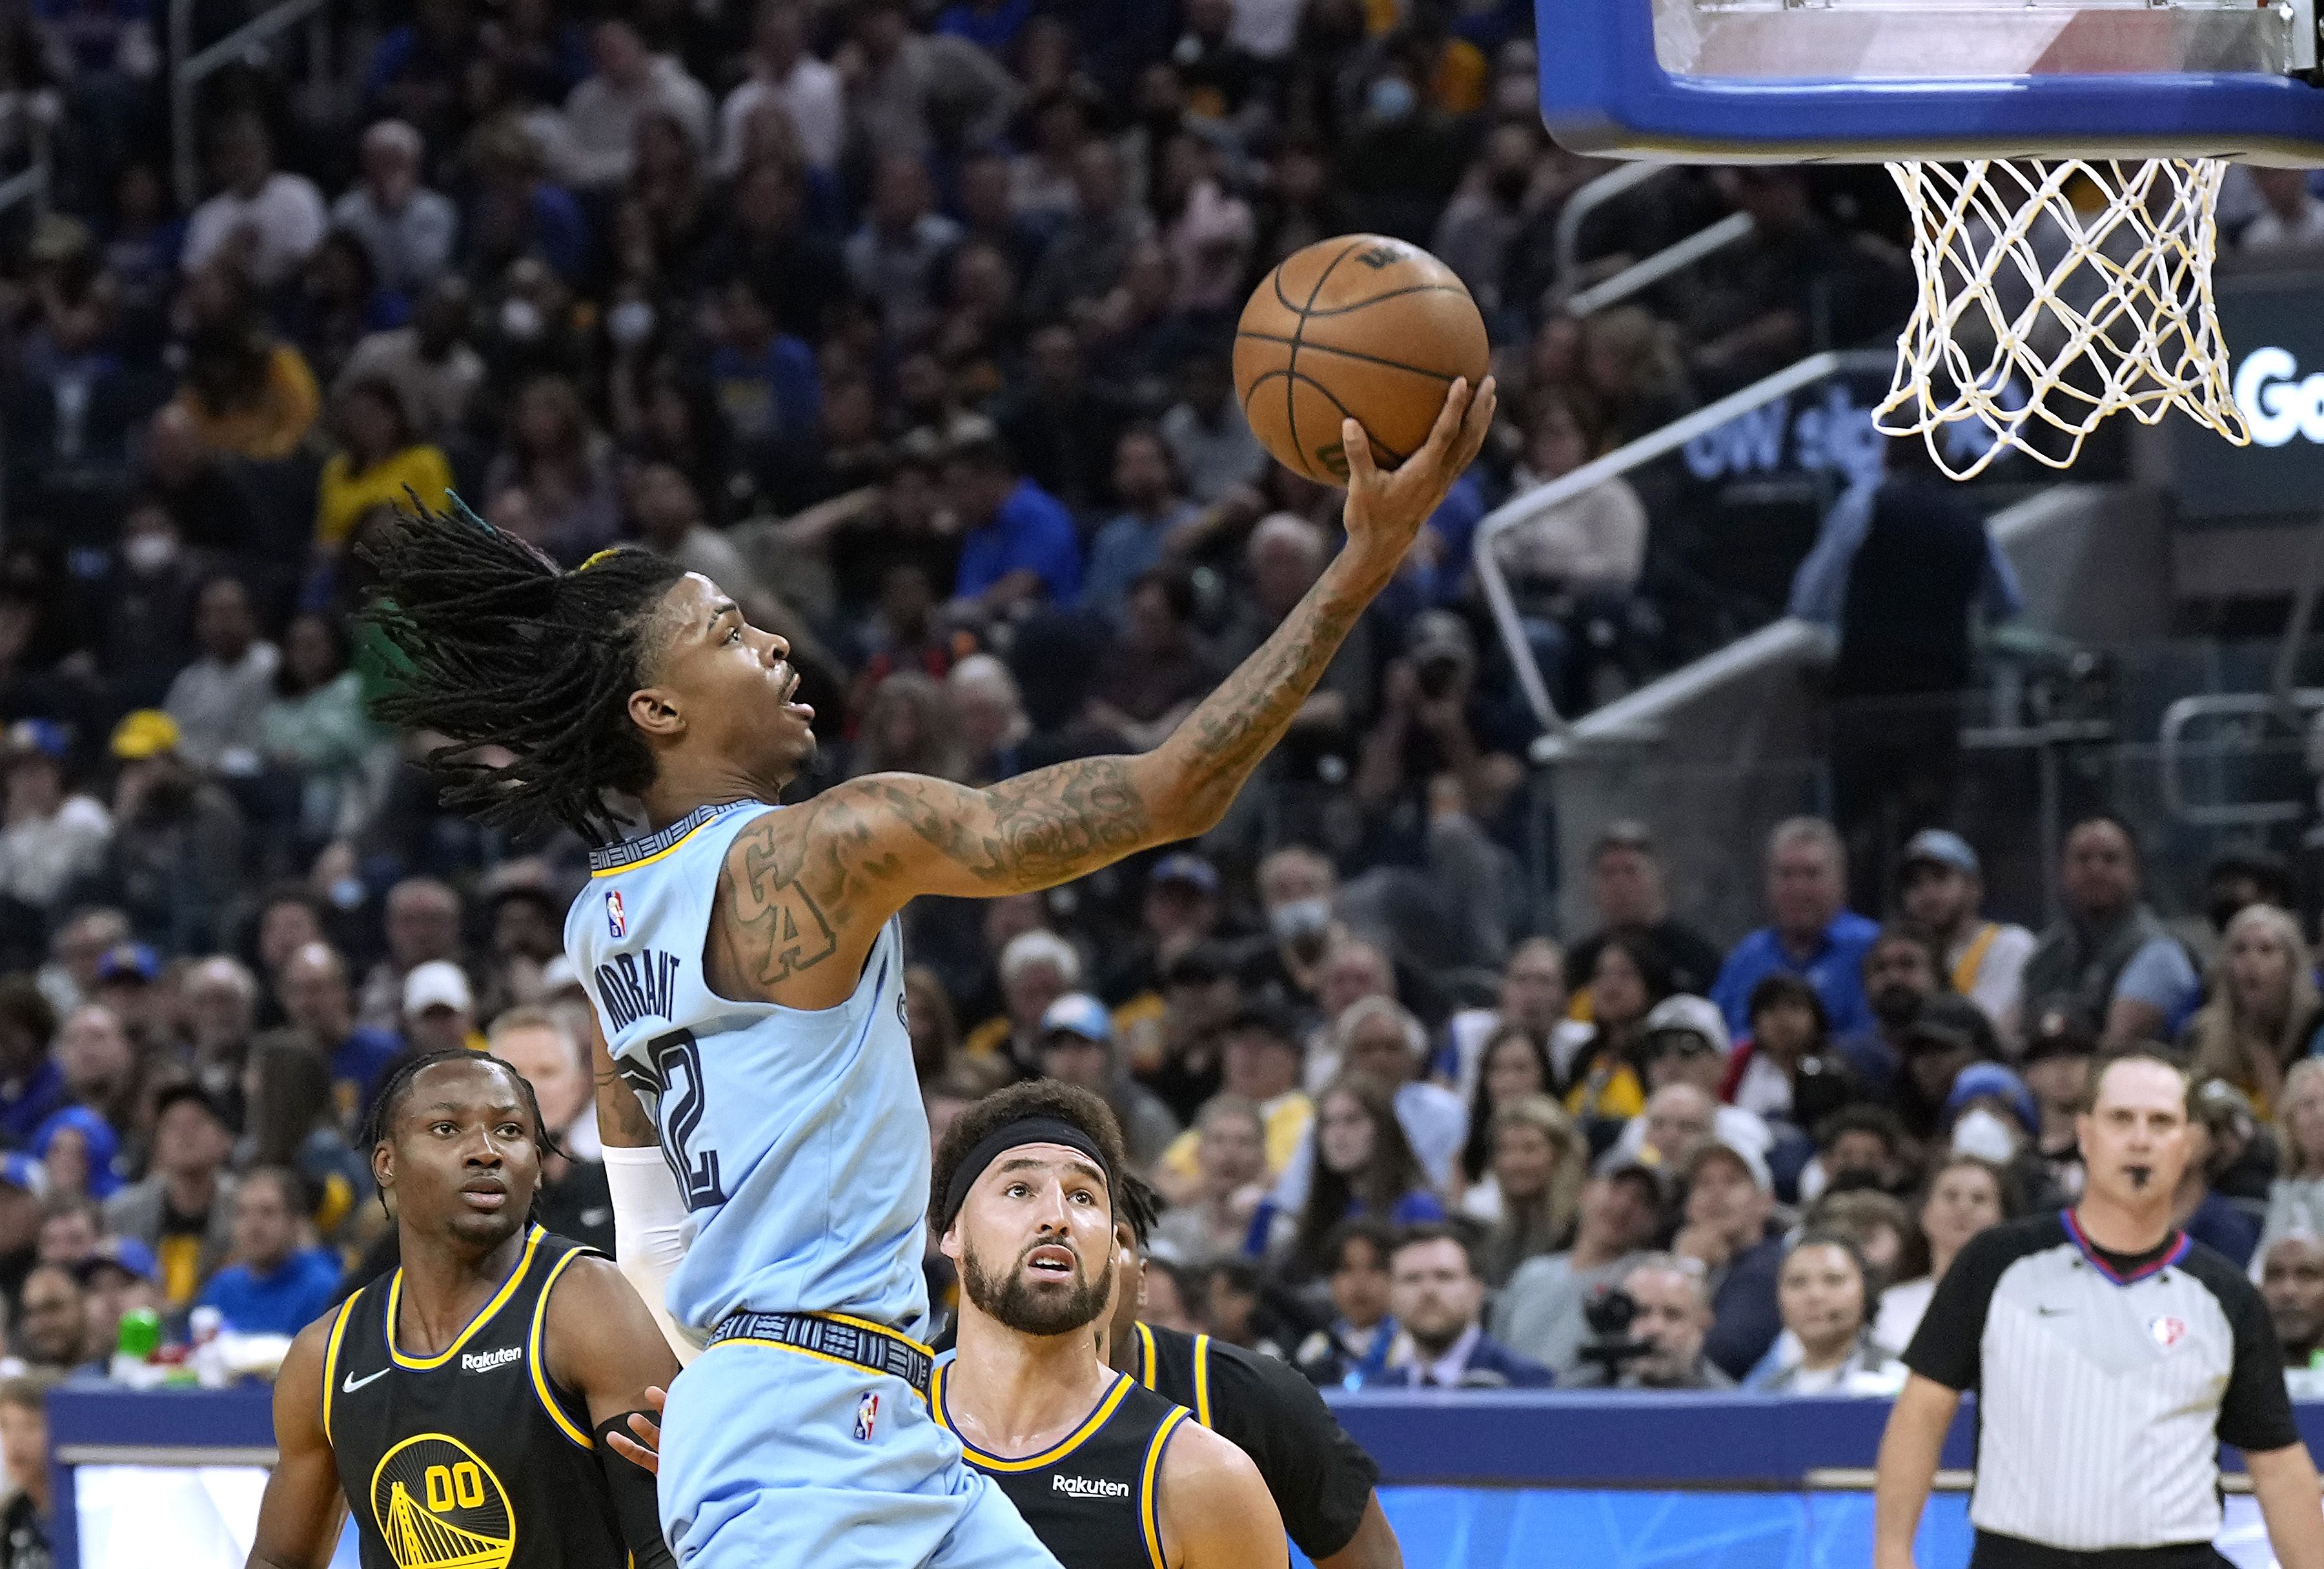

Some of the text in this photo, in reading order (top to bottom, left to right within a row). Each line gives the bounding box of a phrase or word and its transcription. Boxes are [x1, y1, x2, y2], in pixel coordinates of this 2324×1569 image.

[594, 949, 680, 1034] MORANT
[461, 1346, 522, 1373] Rakuten
[424, 1461, 485, 1513] 00
[1052, 1474, 1129, 1497] Rakuten
